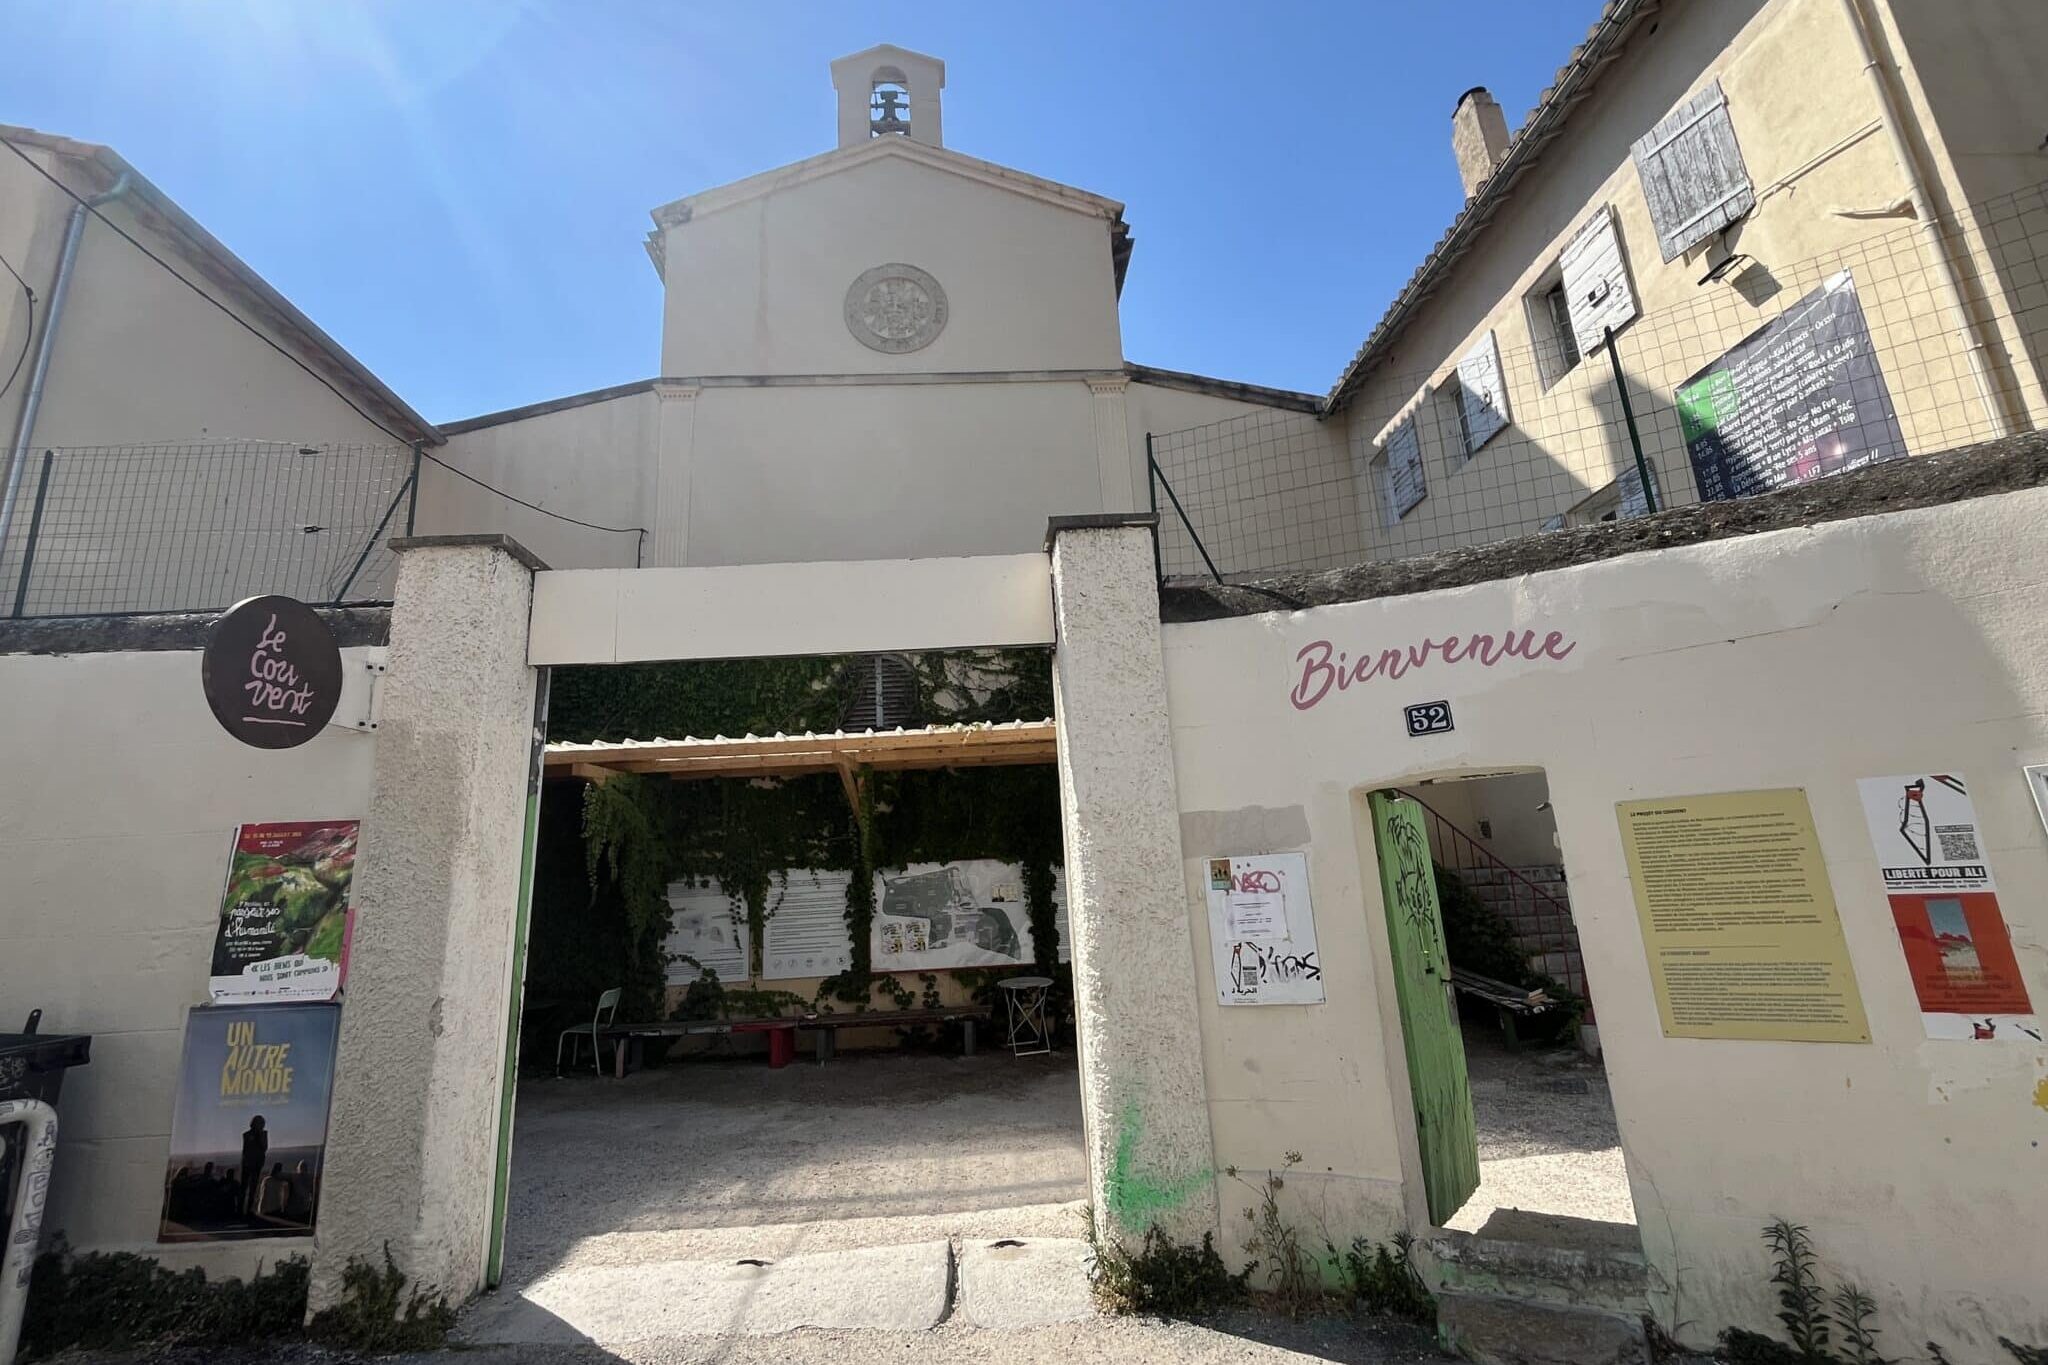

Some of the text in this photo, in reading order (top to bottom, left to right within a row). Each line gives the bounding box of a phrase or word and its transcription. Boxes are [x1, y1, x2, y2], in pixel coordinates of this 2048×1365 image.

[1786, 396, 1798, 410] par
[1822, 398, 1837, 410] Fun
[256, 613, 286, 652] Le
[1290, 629, 1577, 710] Bienvenue
[245, 680, 314, 715] vent
[1411, 705, 1447, 731] 52
[1930, 867, 1962, 879] POUR
[260, 963, 271, 972] LES
[277, 970, 292, 980] SONT
[227, 1021, 256, 1047] UN
[224, 1043, 290, 1070] AUTRE
[222, 1067, 294, 1096] MONDE
